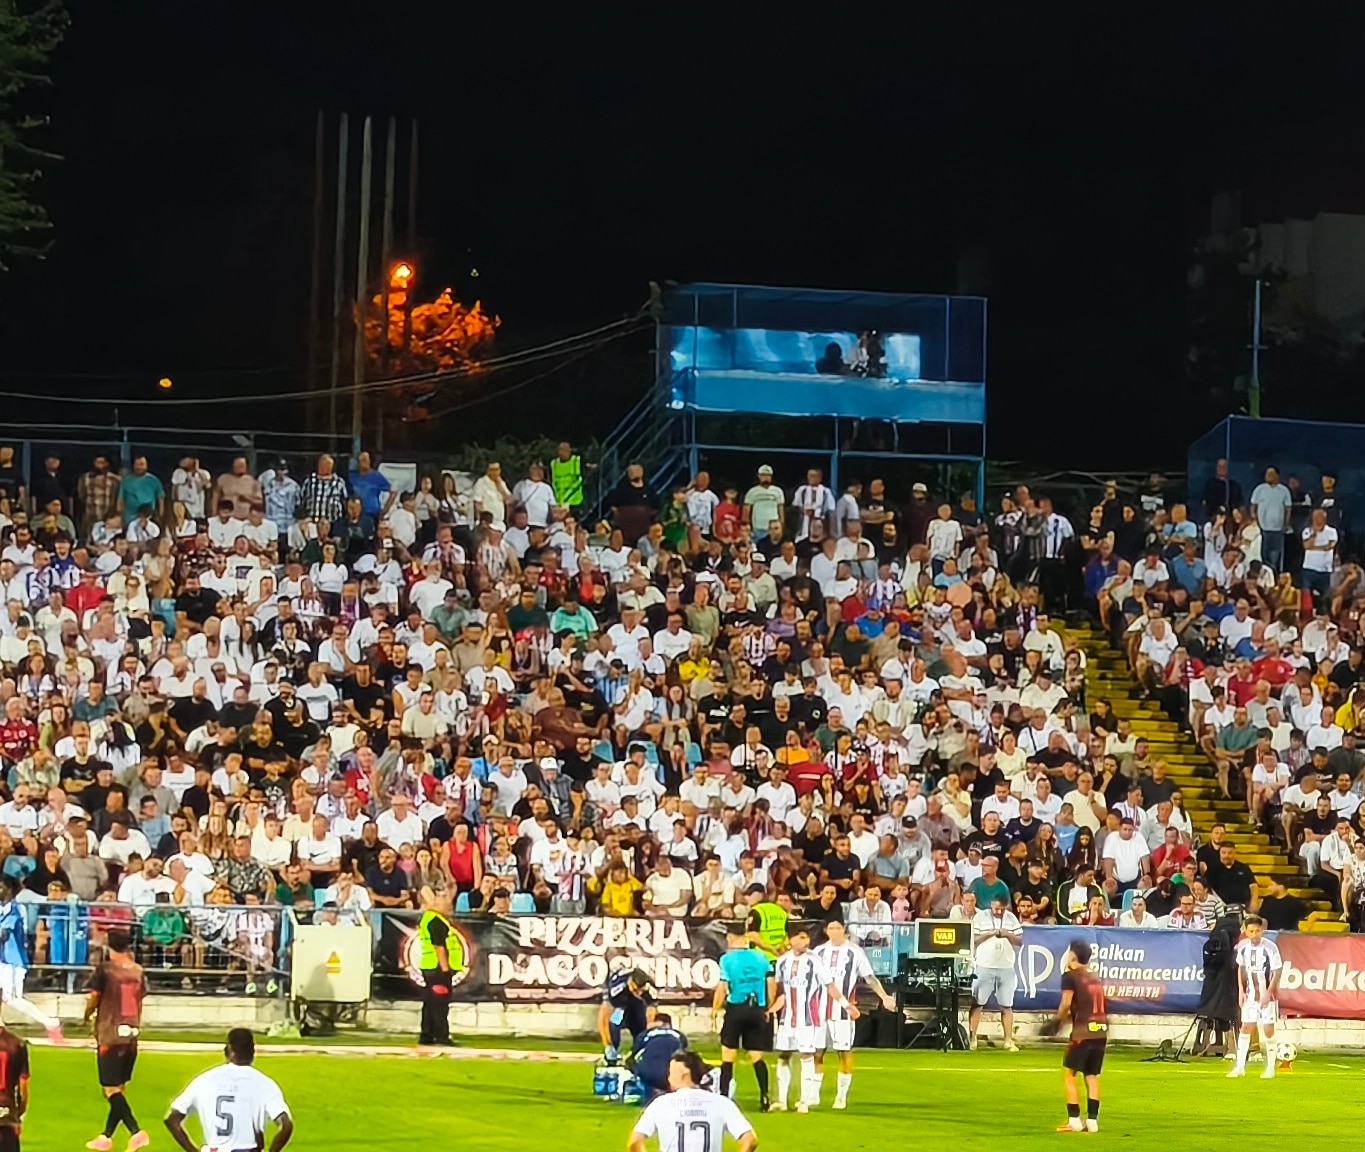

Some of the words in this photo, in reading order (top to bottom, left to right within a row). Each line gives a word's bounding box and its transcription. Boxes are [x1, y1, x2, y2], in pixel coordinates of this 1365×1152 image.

[518, 916, 691, 955] PIZZERIA
[936, 932, 954, 942] VAR
[1090, 962, 1206, 982] Pharmaceutic
[1118, 984, 1160, 999] HEALTH
[215, 1095, 235, 1136] 5
